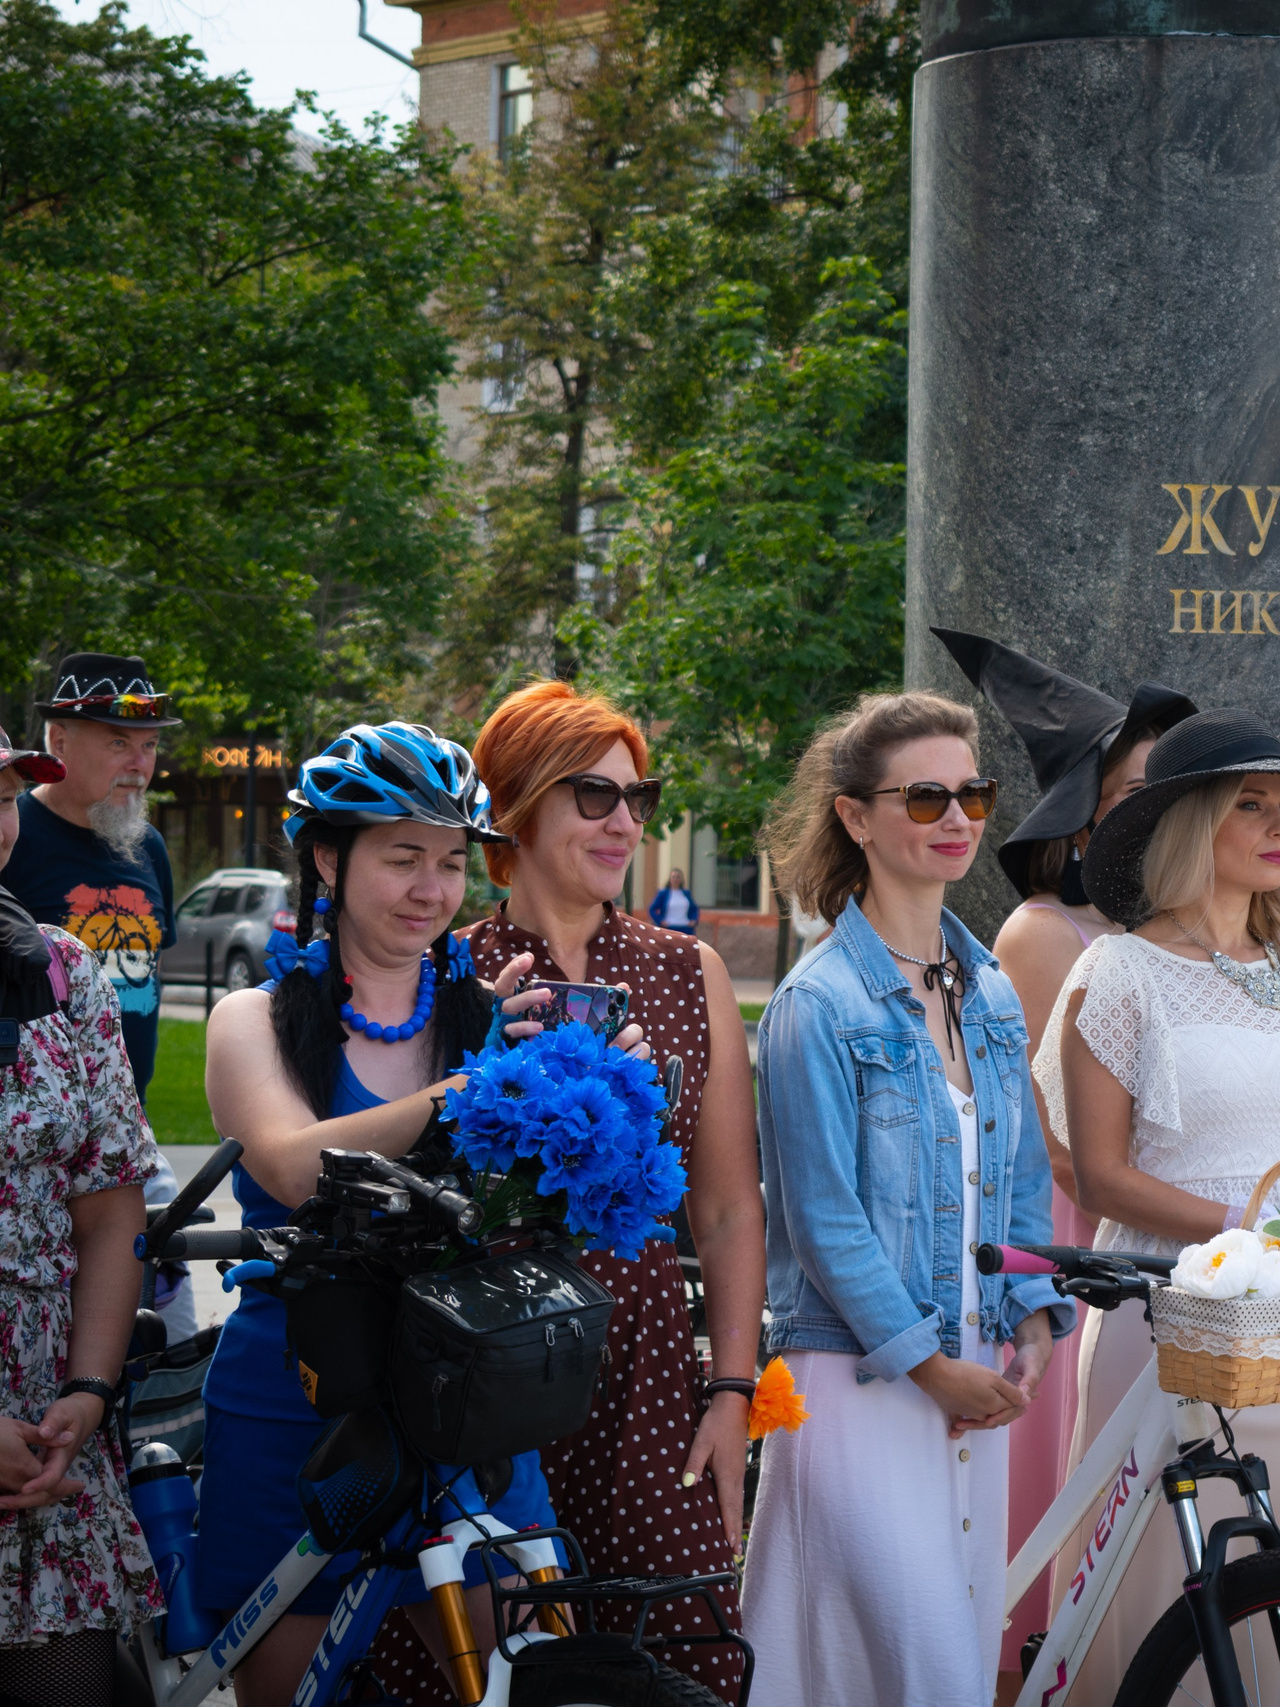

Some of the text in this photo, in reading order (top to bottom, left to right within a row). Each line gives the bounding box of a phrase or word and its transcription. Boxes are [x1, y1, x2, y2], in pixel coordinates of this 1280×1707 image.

[202, 744, 293, 769] КОФЕЙН
[1070, 1446, 1139, 1606] STERN
[211, 1576, 279, 1669] Miss
[293, 1568, 377, 1707] STEL
